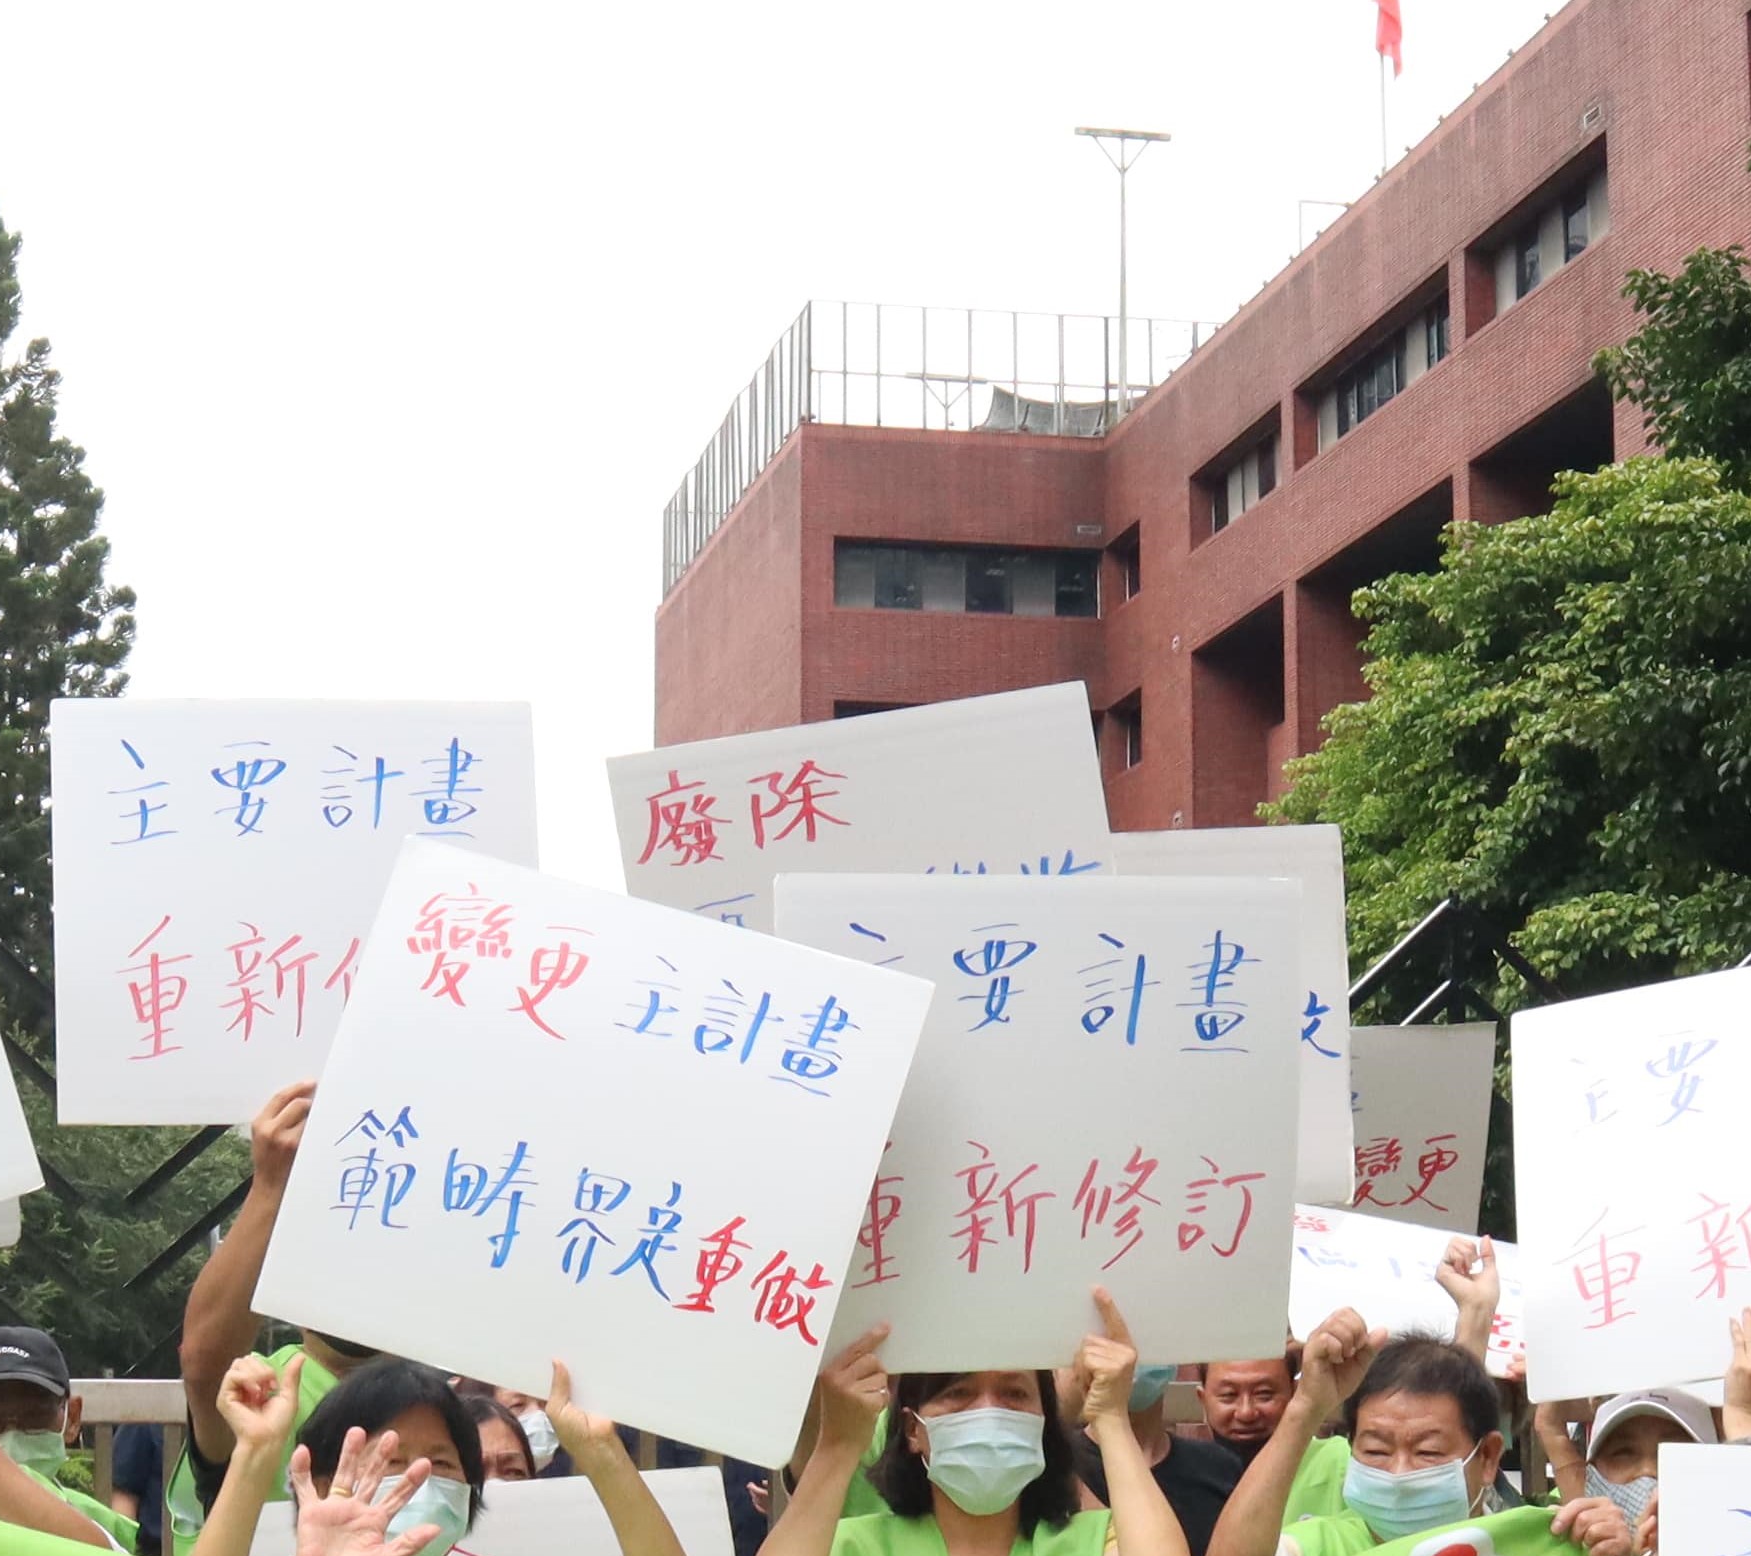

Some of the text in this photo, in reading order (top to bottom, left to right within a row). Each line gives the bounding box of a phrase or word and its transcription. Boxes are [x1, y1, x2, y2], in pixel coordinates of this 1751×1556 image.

[107, 737, 484, 844] 主要計畫
[637, 760, 852, 867] 廢除
